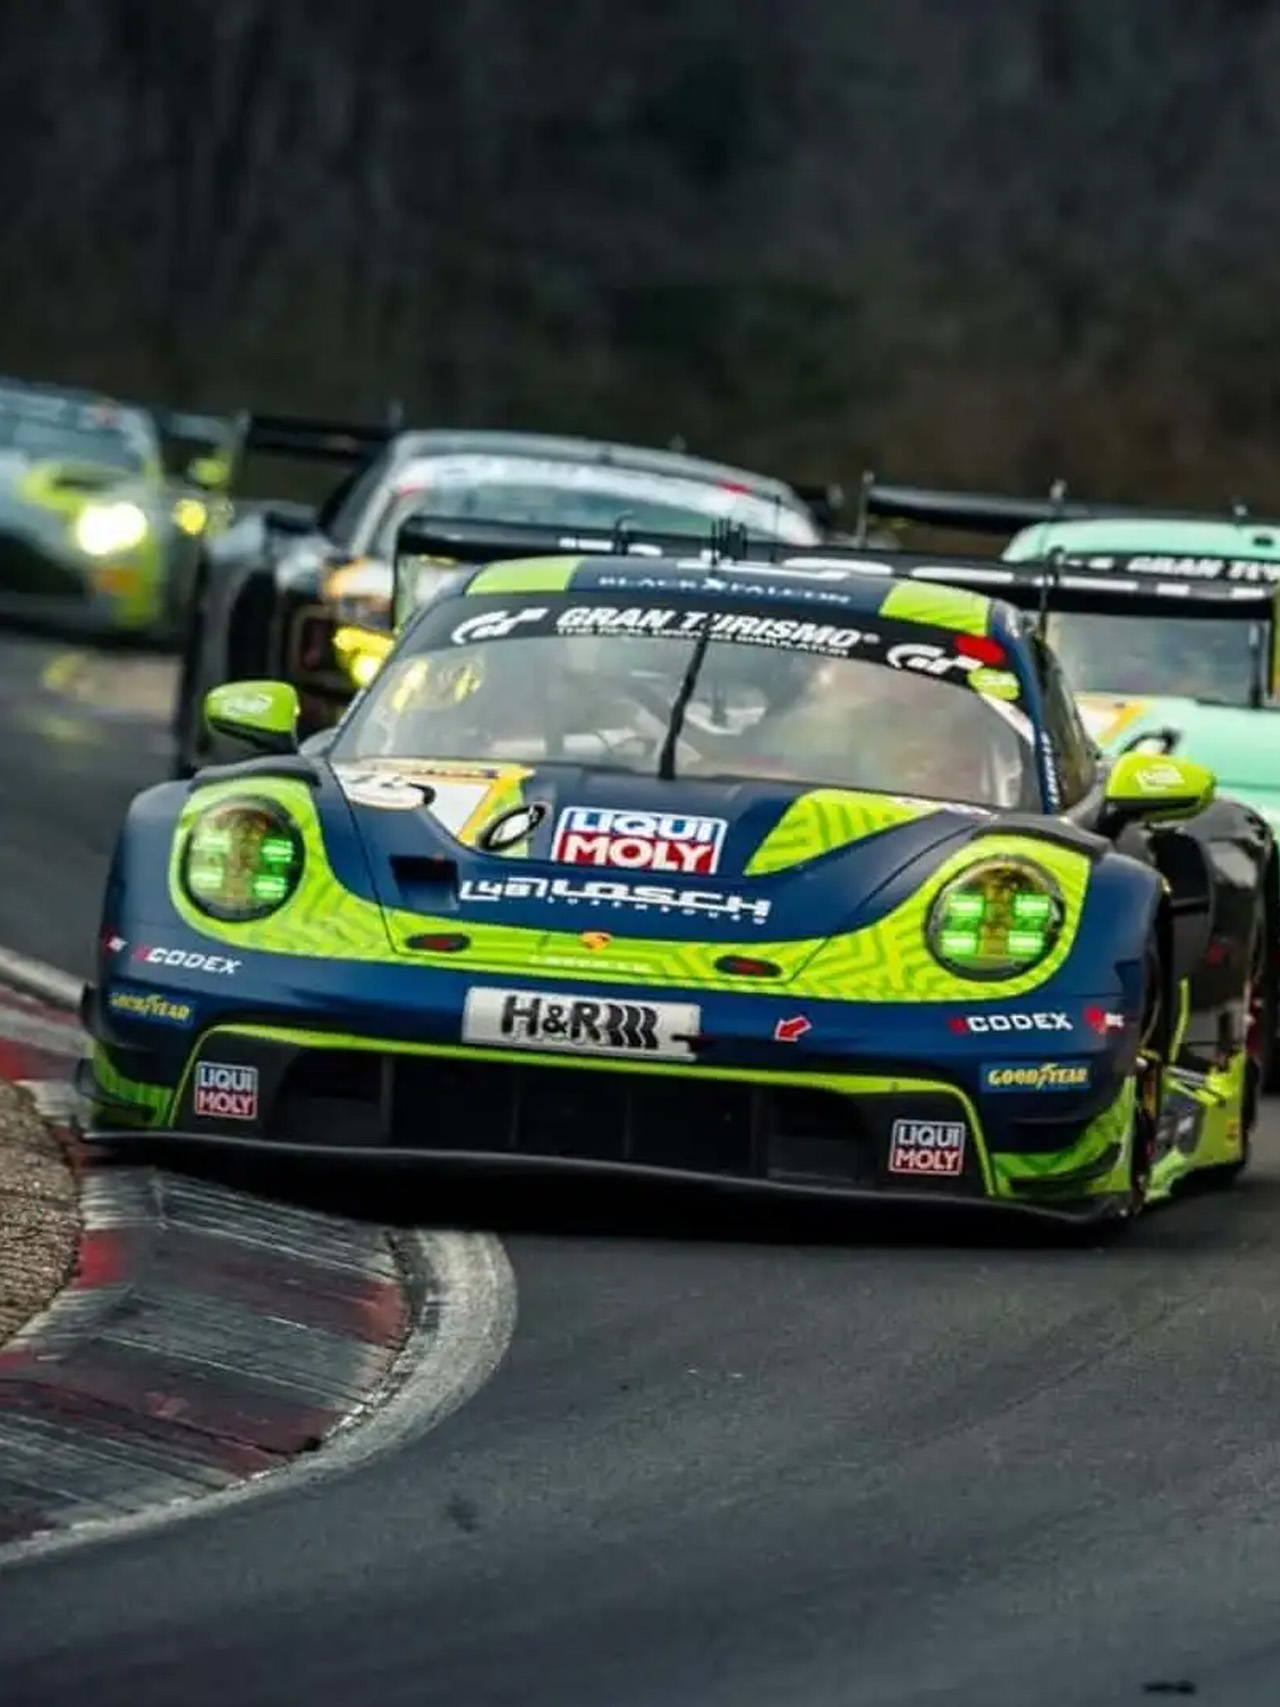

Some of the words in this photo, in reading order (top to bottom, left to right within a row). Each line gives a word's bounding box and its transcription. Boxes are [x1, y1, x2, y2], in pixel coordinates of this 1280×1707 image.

[556, 607, 676, 628] GRAN
[570, 811, 713, 842] LIQUI
[562, 834, 712, 875] MOLY
[551, 879, 772, 918] LOSCH
[144, 947, 244, 975] CODEX
[966, 1012, 1074, 1032] CODEX
[200, 1067, 254, 1091] LIQUI
[987, 1061, 1089, 1090] GOODYEAR
[198, 1087, 255, 1115] MOLY
[898, 1125, 960, 1149] LIQUI
[894, 1149, 960, 1172] MOLY
